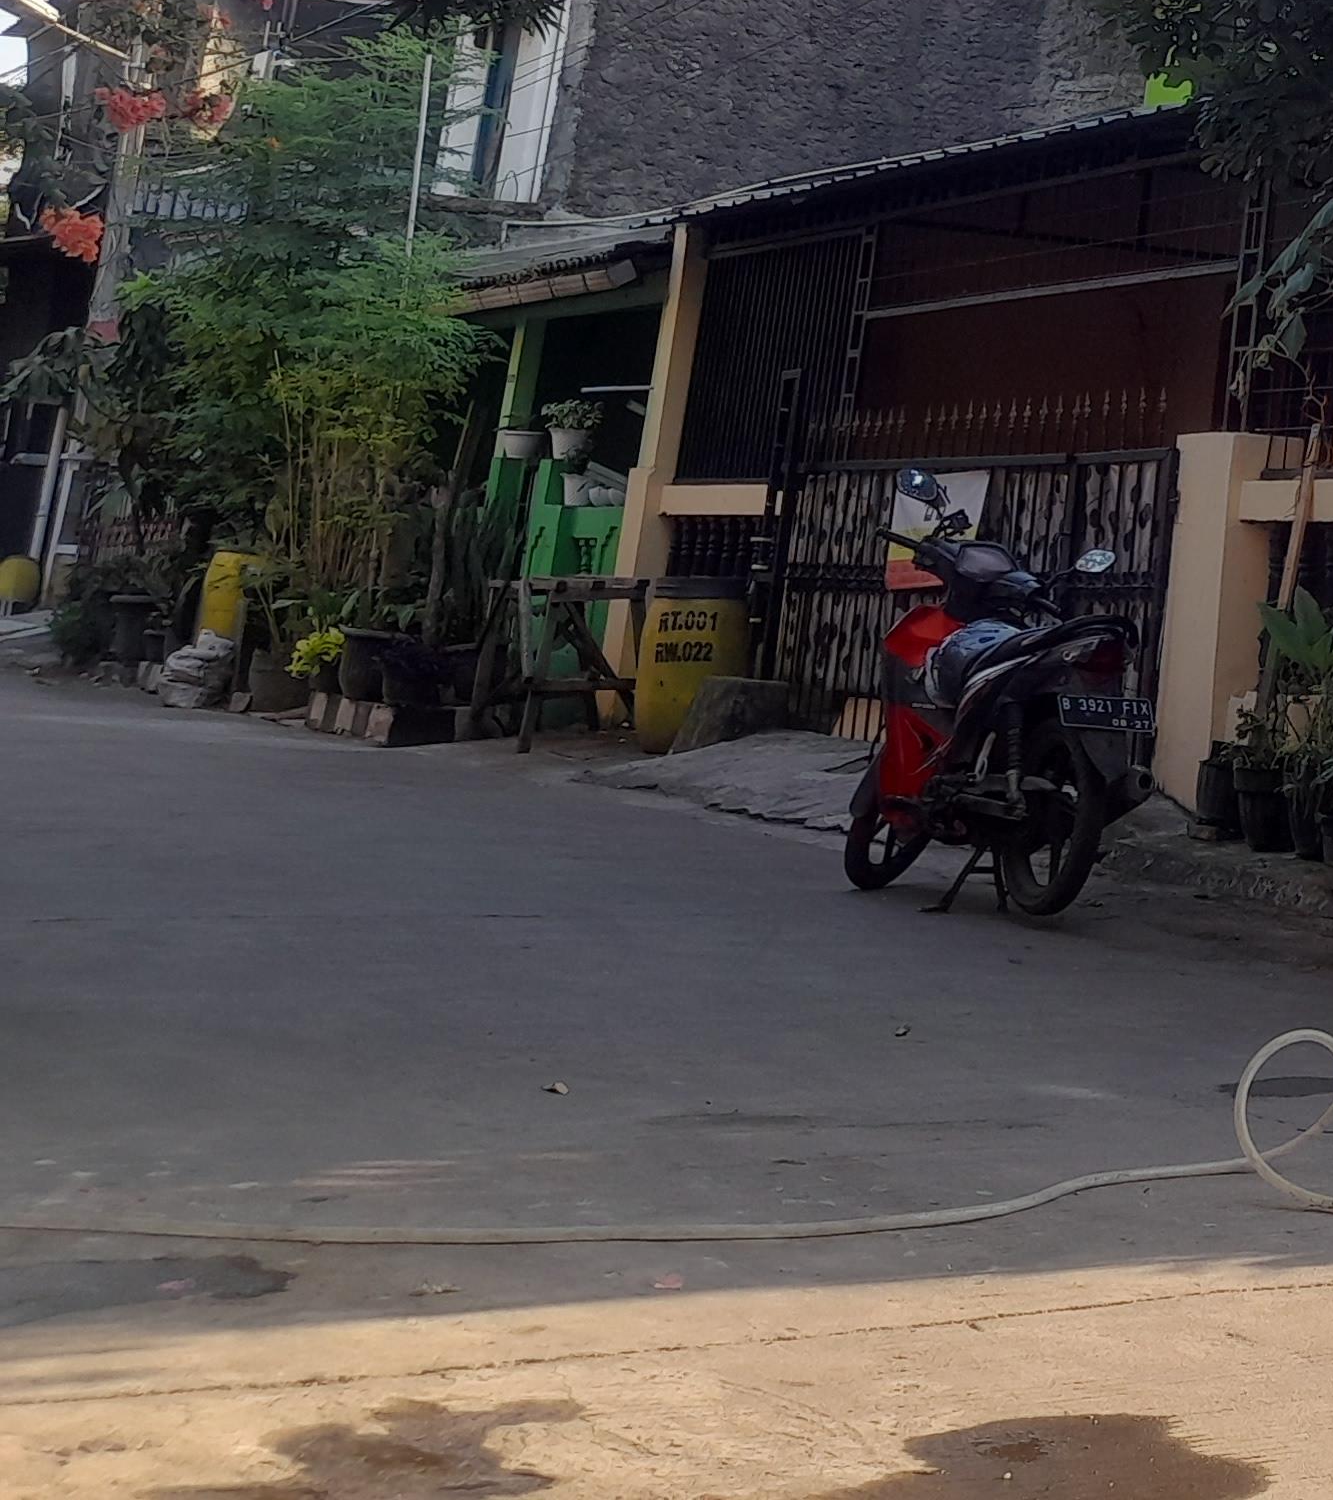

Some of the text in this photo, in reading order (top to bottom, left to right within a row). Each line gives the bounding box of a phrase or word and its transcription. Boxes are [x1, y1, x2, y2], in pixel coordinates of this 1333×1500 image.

[657, 610, 719, 633] RT.001
[654, 641, 713, 663] RW.022
[1061, 697, 1150, 715] B 3921 FIX
